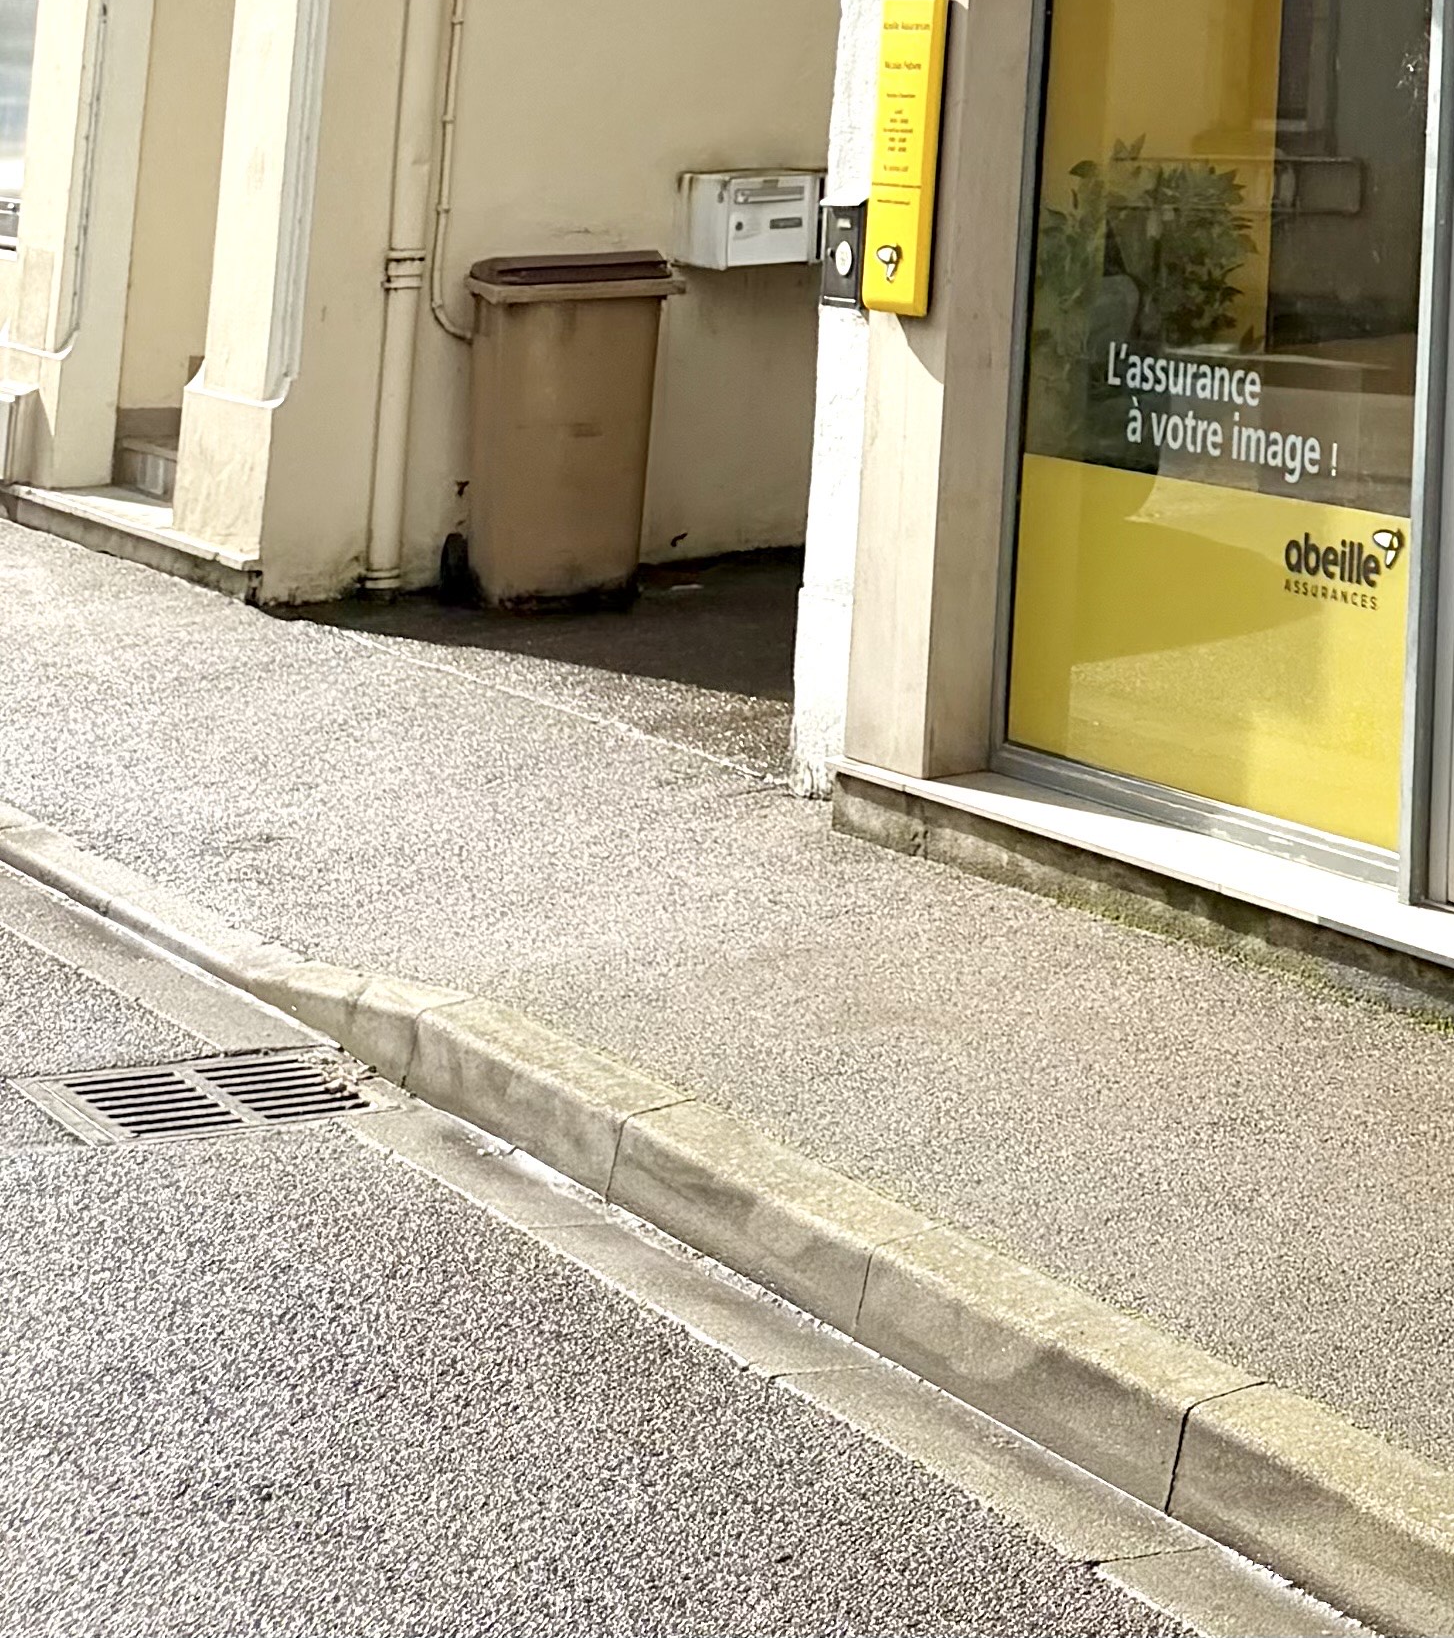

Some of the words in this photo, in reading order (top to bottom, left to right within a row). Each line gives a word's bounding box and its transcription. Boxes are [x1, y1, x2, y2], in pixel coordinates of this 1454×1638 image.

[1107, 341, 1262, 407] L'assurance
[1127, 396, 1143, 444] à
[1151, 410, 1224, 458] votre
[1231, 411, 1322, 484] image
[1331, 442, 1338, 477] !
[1285, 532, 1381, 588] abeille
[1284, 578, 1378, 611] ASSURANCES
